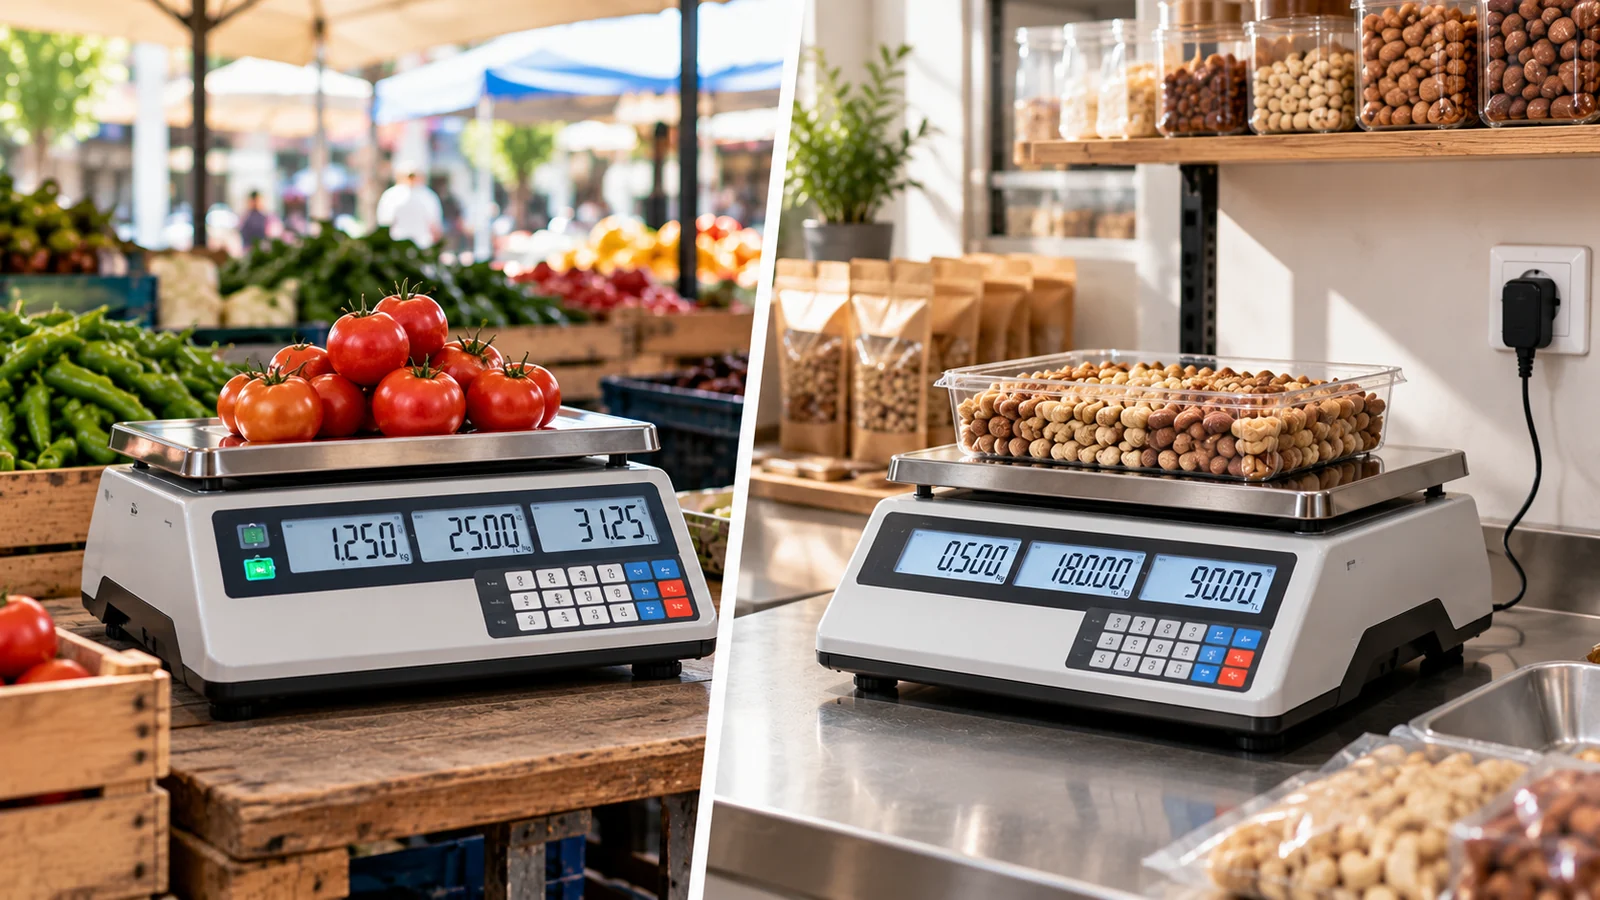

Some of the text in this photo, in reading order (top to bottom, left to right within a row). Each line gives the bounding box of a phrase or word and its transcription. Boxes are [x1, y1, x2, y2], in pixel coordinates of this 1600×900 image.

[332, 522, 398, 561] 1.250
[574, 505, 645, 542] 31.25
[937, 541, 1009, 576] 0.500
[1185, 566, 1262, 611] 90.00 TL
